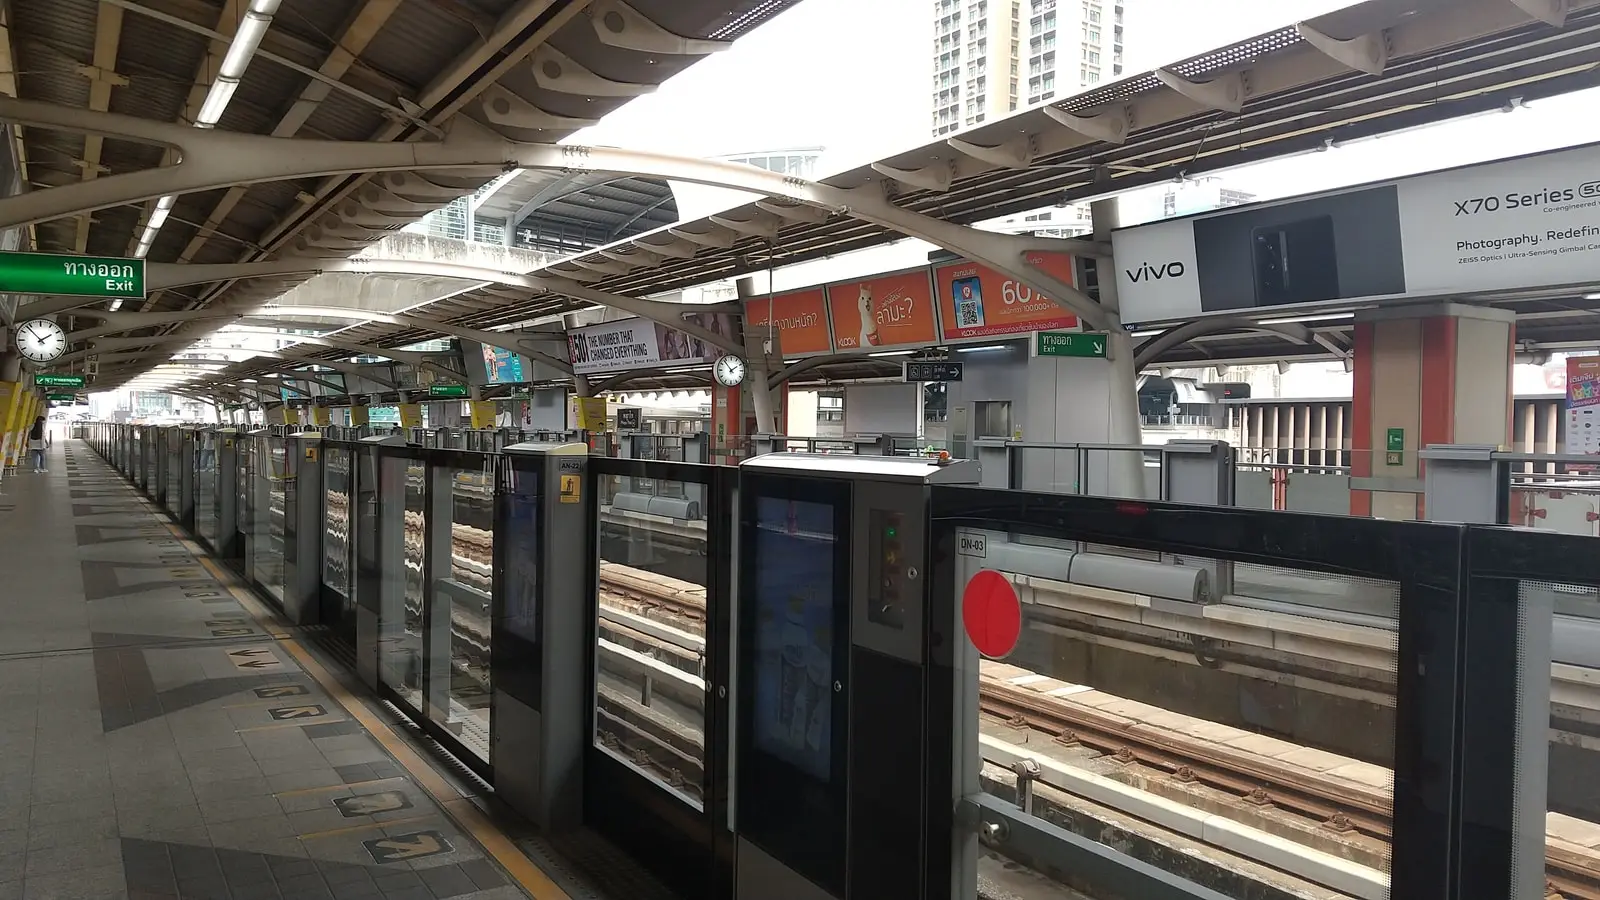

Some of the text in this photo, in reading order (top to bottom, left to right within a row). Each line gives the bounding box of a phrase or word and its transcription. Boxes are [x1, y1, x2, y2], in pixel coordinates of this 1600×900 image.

[1454, 197, 1499, 216] X70
[1505, 188, 1574, 209] Series
[1543, 200, 1596, 213] Co-engineered
[1456, 234, 1543, 251] Photography.
[1458, 256, 1479, 264] ZEISS
[1480, 254, 1503, 263] Optics
[1507, 249, 1558, 259] Ultra-Sensing
[1558, 245, 1586, 254] Gimbal
[64, 262, 134, 278] ทางออก
[1126, 261, 1185, 283] vivo
[105, 280, 133, 291] Exit
[876, 297, 914, 325] ลามะ?
[588, 336, 598, 348] THE
[598, 332, 620, 346] NUMBER
[619, 330, 634, 342] THAT
[961, 329, 977, 337] KLOOK
[837, 337, 856, 347] KLOOK
[1043, 335, 1072, 346] ทางออก
[590, 347, 614, 361] CHANGED
[614, 343, 648, 359] EVERYTHING
[1043, 345, 1056, 353] Exit
[561, 462, 580, 470] AN-22
[961, 538, 984, 551] DN-03
